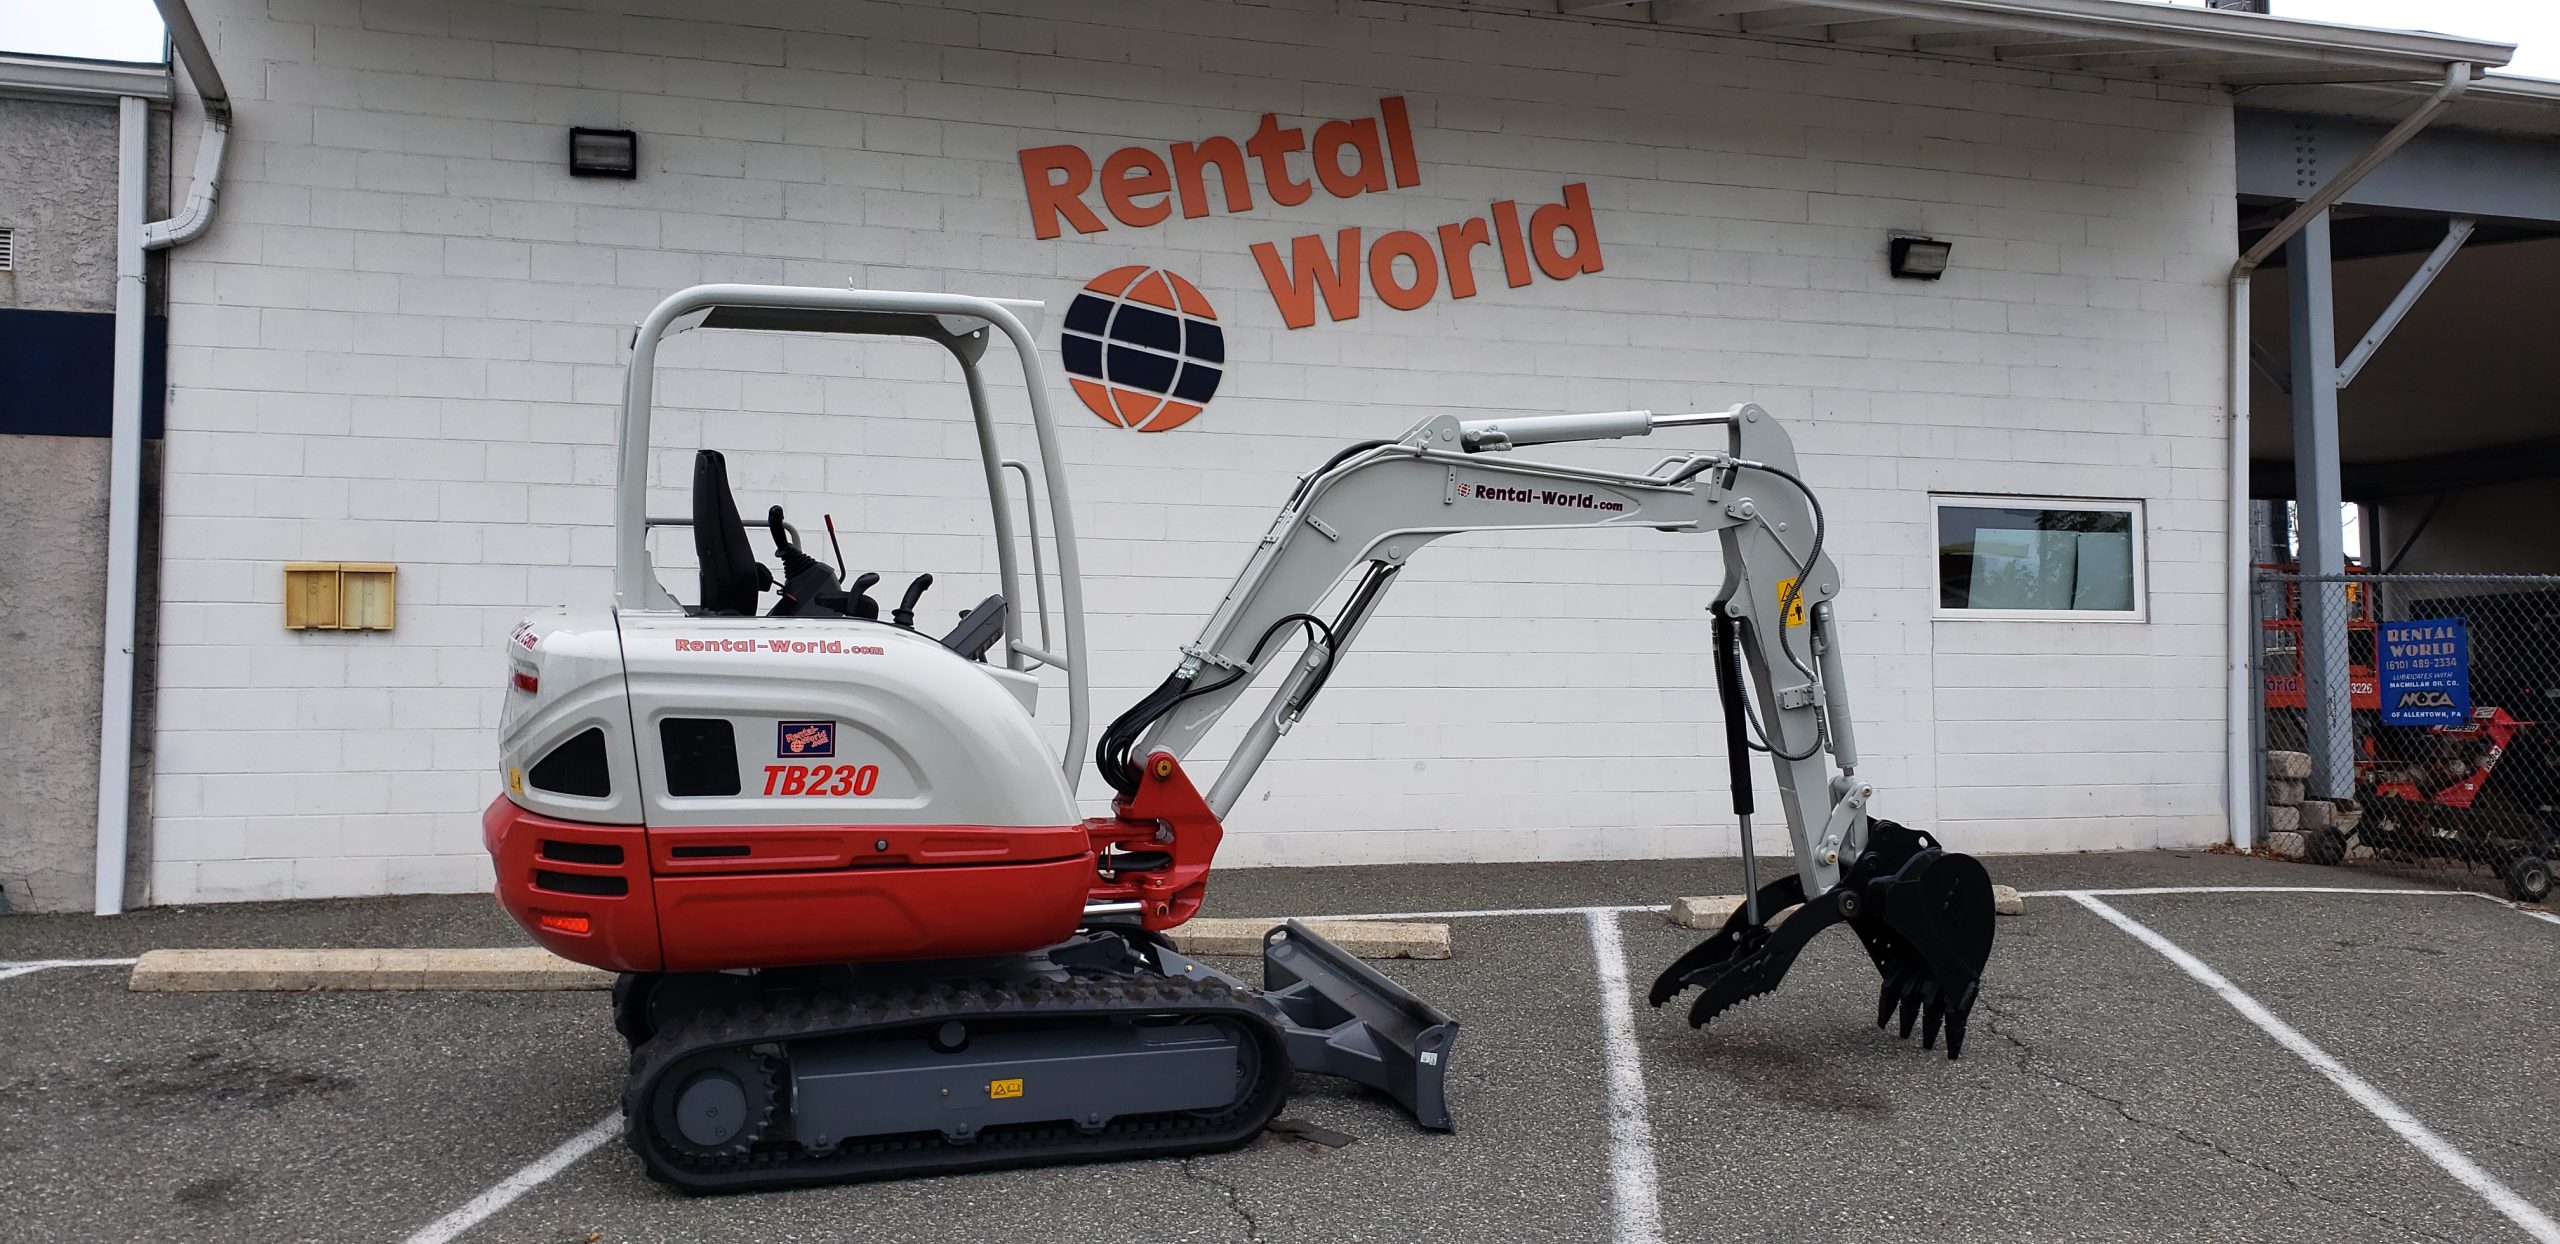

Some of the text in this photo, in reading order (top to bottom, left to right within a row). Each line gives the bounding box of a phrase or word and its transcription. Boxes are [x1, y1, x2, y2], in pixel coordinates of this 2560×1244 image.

[1019, 95, 1421, 240] Rental
[1250, 182, 1604, 330] World
[1475, 484, 1623, 511] Rental-World.com
[2387, 626, 2456, 642] RENTAL
[675, 638, 884, 656] Rental-World.com
[2390, 642, 2455, 657] WORLD
[2386, 657, 2457, 670] (610) 489-2334
[2434, 671, 2453, 679] WITH
[2264, 678, 2297, 692] orld
[2351, 683, 2373, 694] 3226
[2398, 691, 2456, 708] MOCA
[2403, 711, 2449, 719] ALLENTOWN,
[763, 765, 879, 796] TB230
